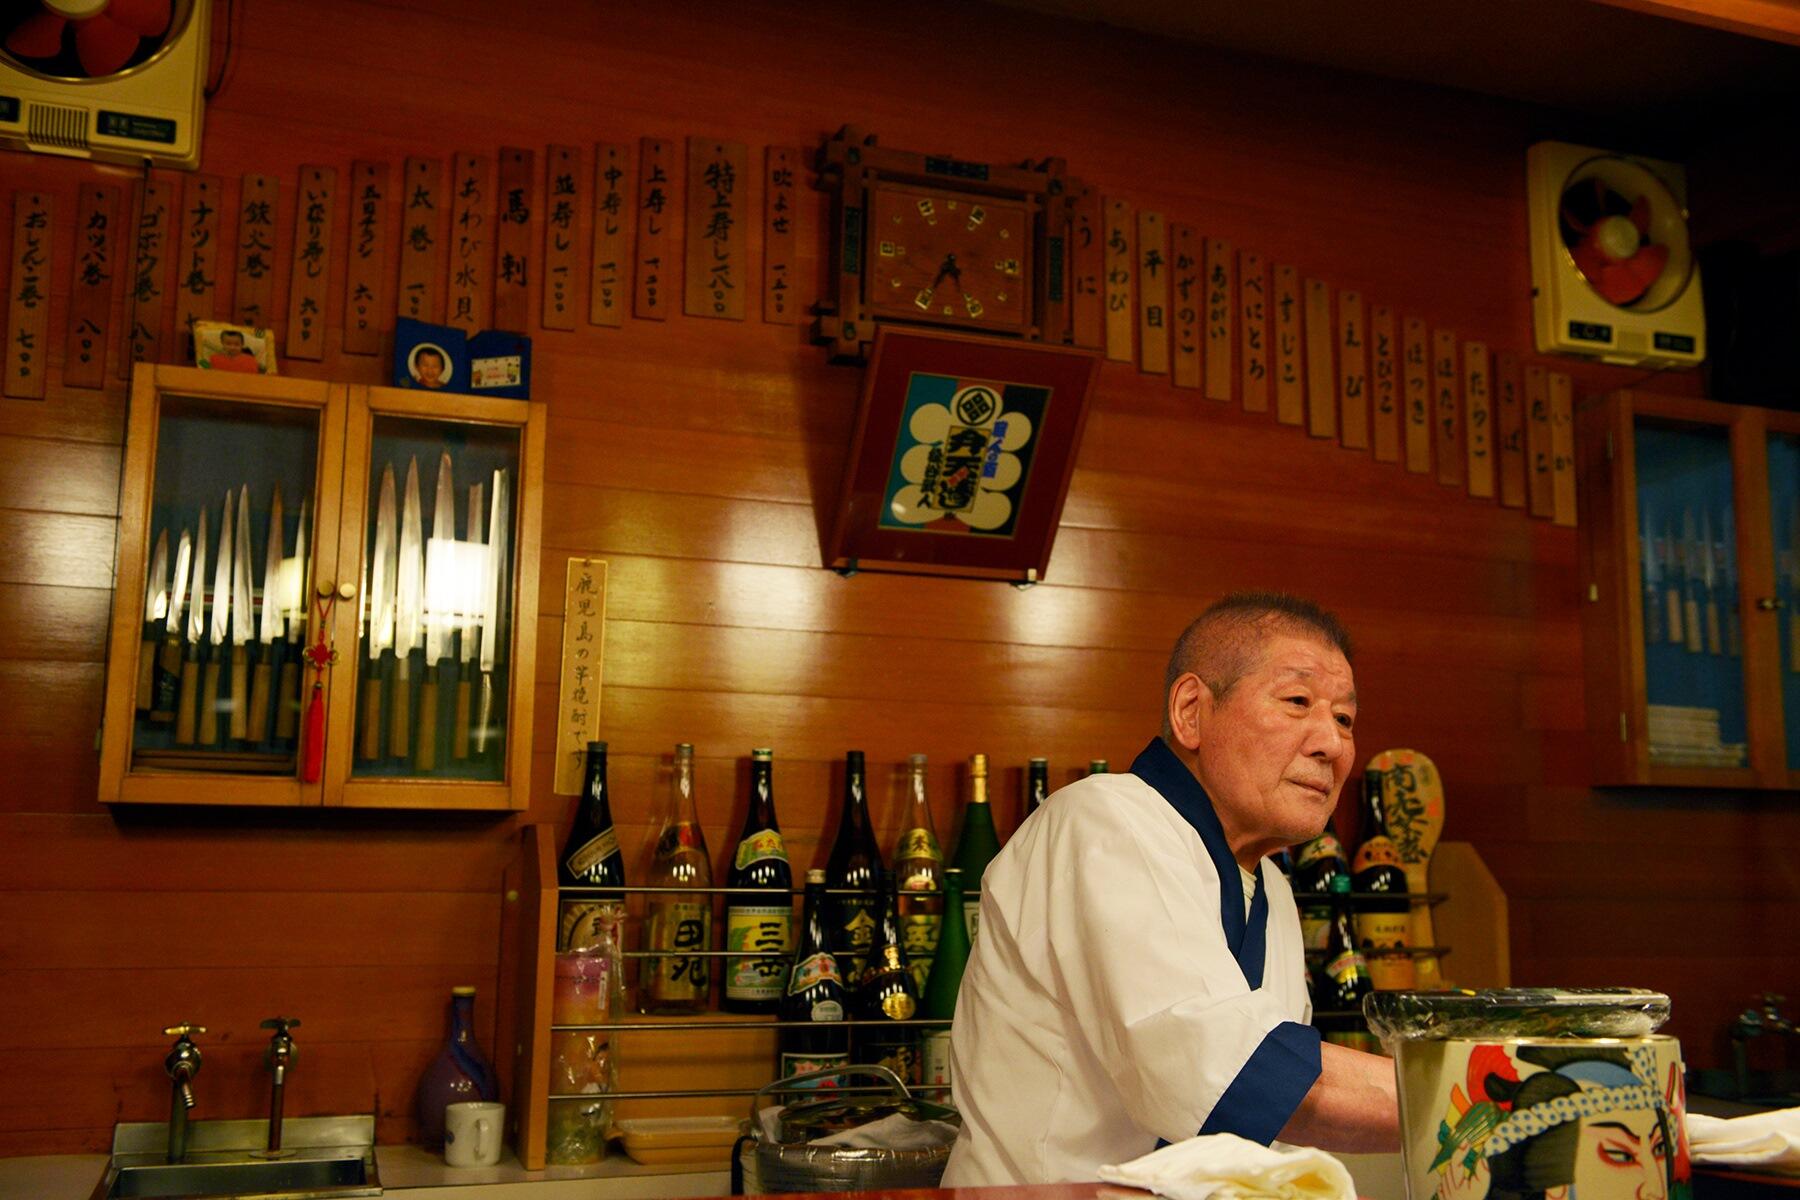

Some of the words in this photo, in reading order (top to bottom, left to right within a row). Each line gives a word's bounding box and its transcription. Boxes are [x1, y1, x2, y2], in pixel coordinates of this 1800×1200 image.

[500, 188, 530, 288] 馬刺
[599, 164, 623, 236] 中寿し
[642, 165, 667, 234] 上寿し
[454, 176, 482, 322] あわび水貝
[1077, 214, 1097, 296] うに
[1108, 228, 1129, 312] あわび
[1145, 249, 1164, 328] 平目
